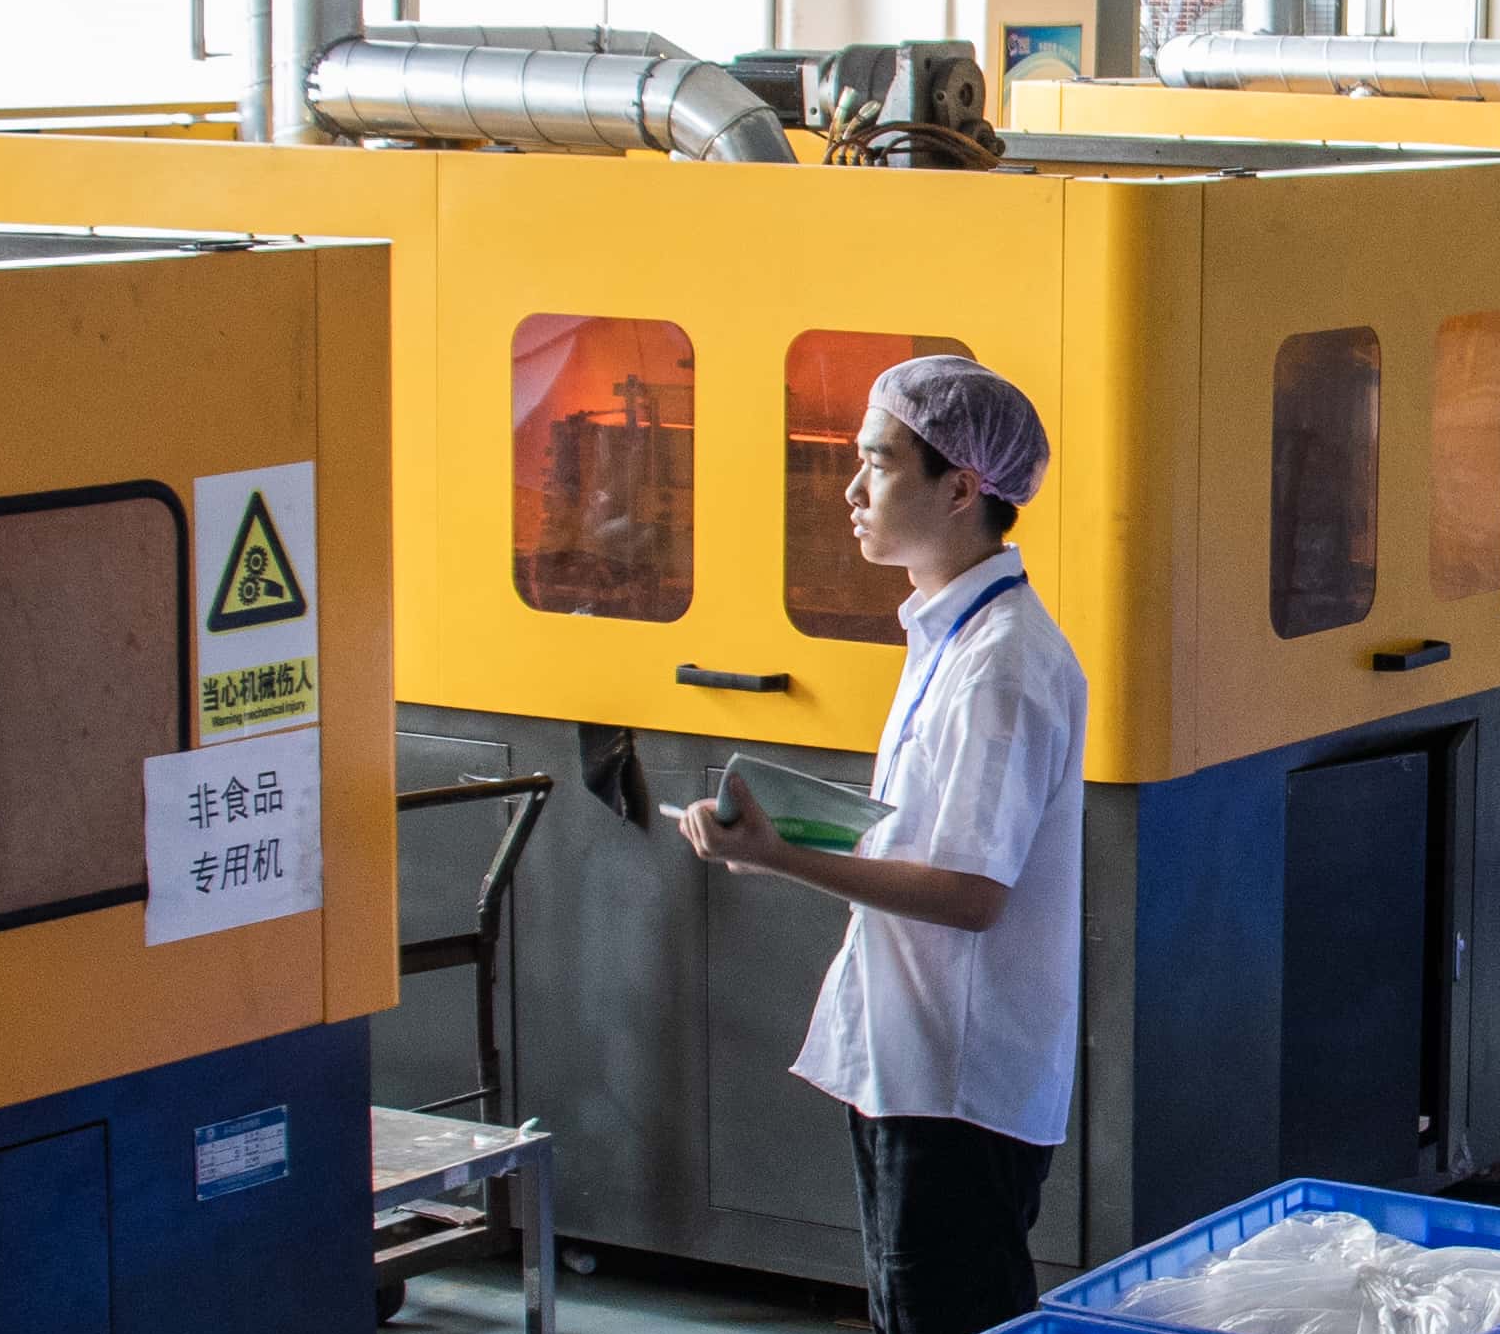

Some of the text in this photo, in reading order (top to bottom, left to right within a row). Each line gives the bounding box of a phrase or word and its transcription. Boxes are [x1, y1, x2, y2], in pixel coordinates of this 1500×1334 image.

[203, 660, 313, 712] 当心机械伤人
[188, 771, 283, 828] 非食品
[190, 838, 284, 893] 专用机
